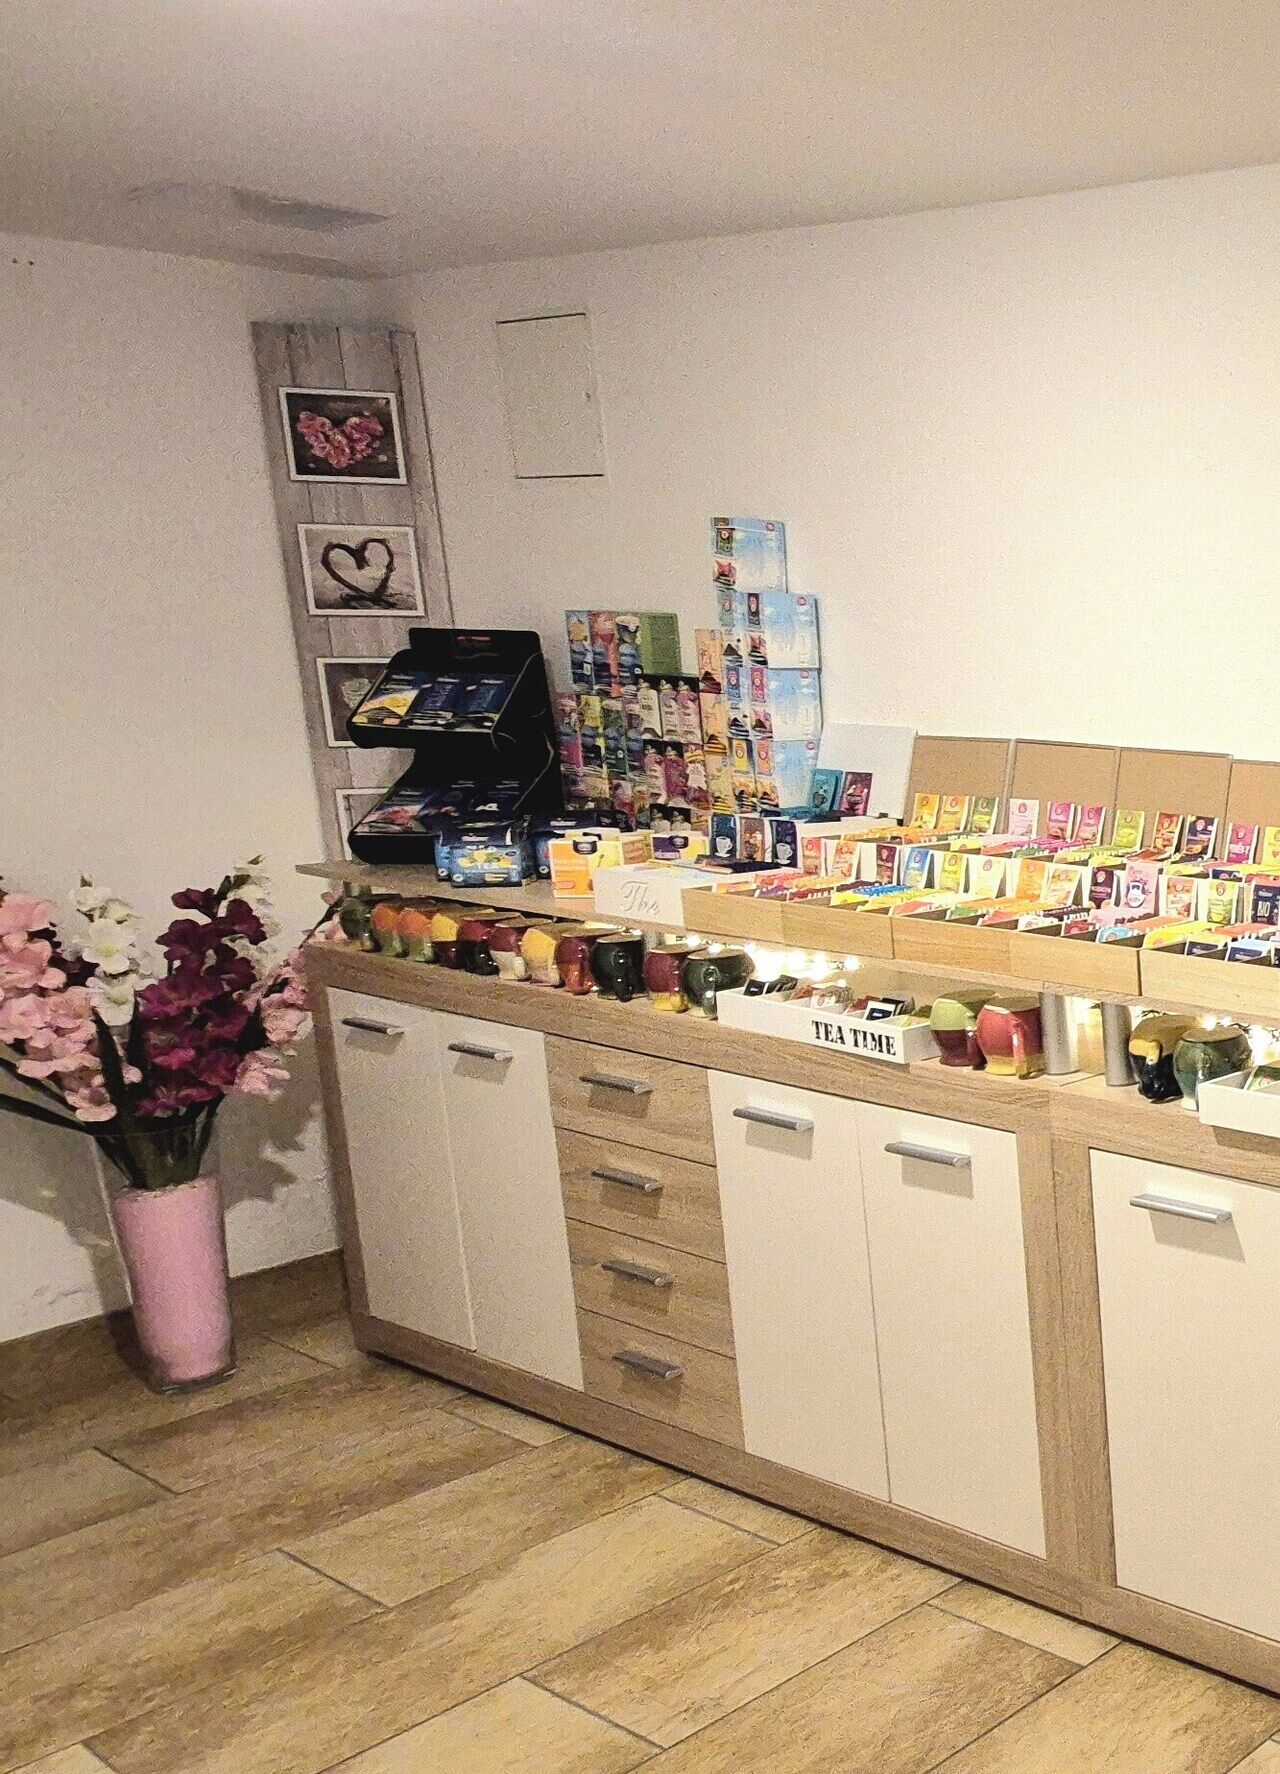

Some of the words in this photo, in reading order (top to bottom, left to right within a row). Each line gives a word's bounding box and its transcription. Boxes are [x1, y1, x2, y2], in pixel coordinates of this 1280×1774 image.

[1257, 900, 1271, 917] BIO
[811, 1020, 846, 1045] TEA
[849, 1027, 896, 1056] TIME
